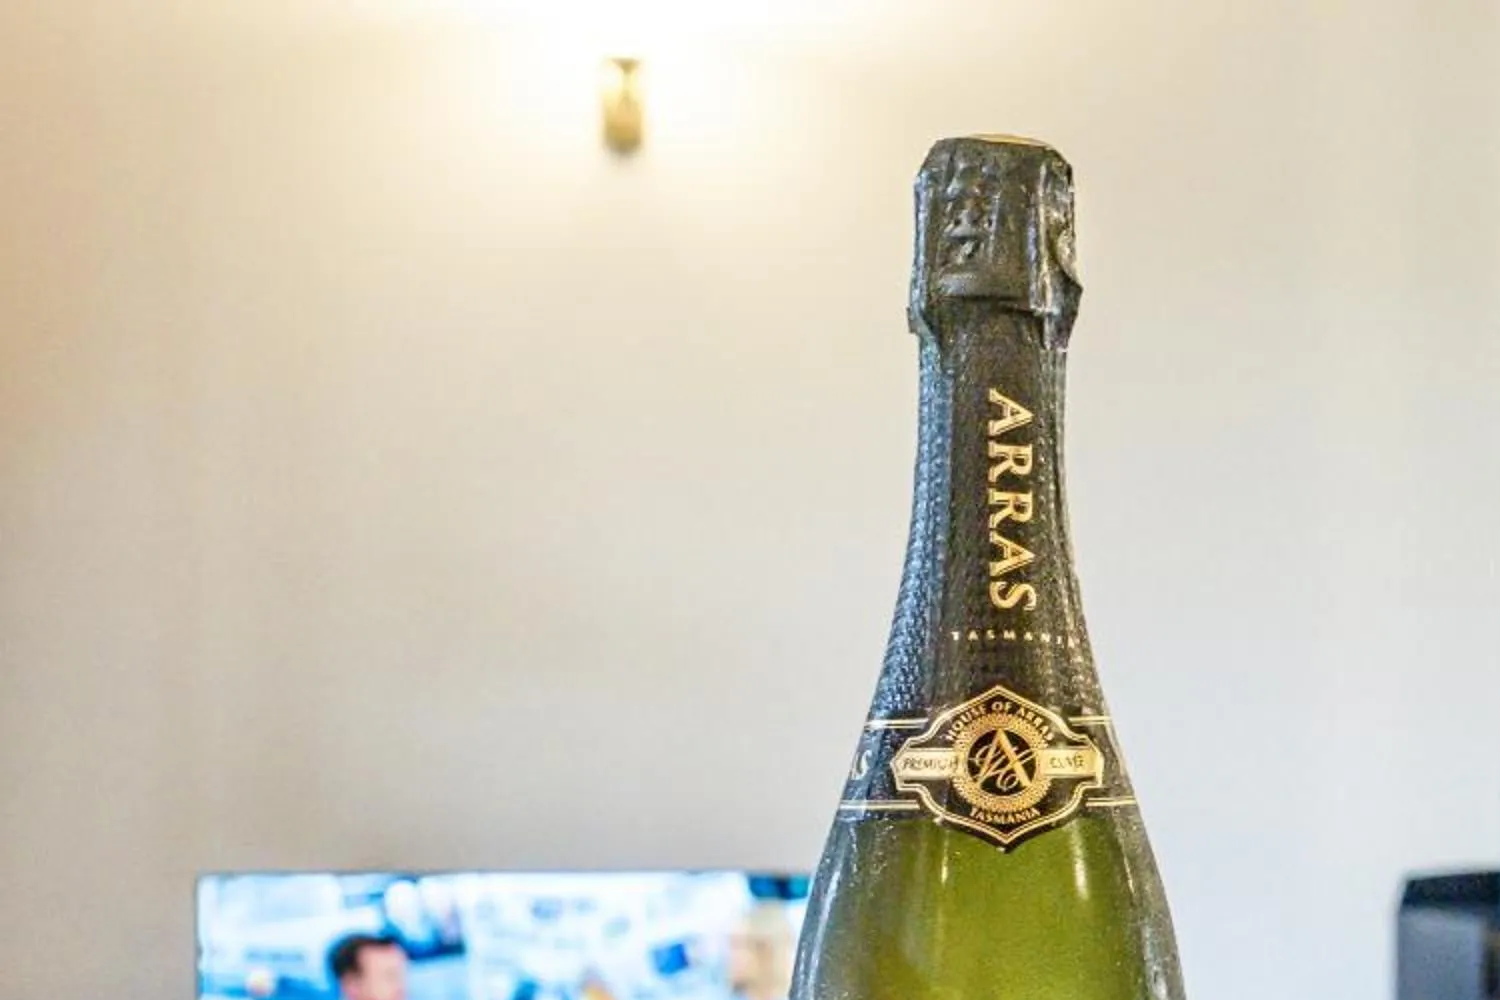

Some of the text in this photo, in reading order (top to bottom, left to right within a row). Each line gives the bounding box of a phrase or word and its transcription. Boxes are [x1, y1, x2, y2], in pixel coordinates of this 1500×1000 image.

[988, 387, 1037, 611] ARRAS
[945, 701, 1054, 741] HOUSE OF ARRAS
[970, 807, 1041, 825] TASMANIA
